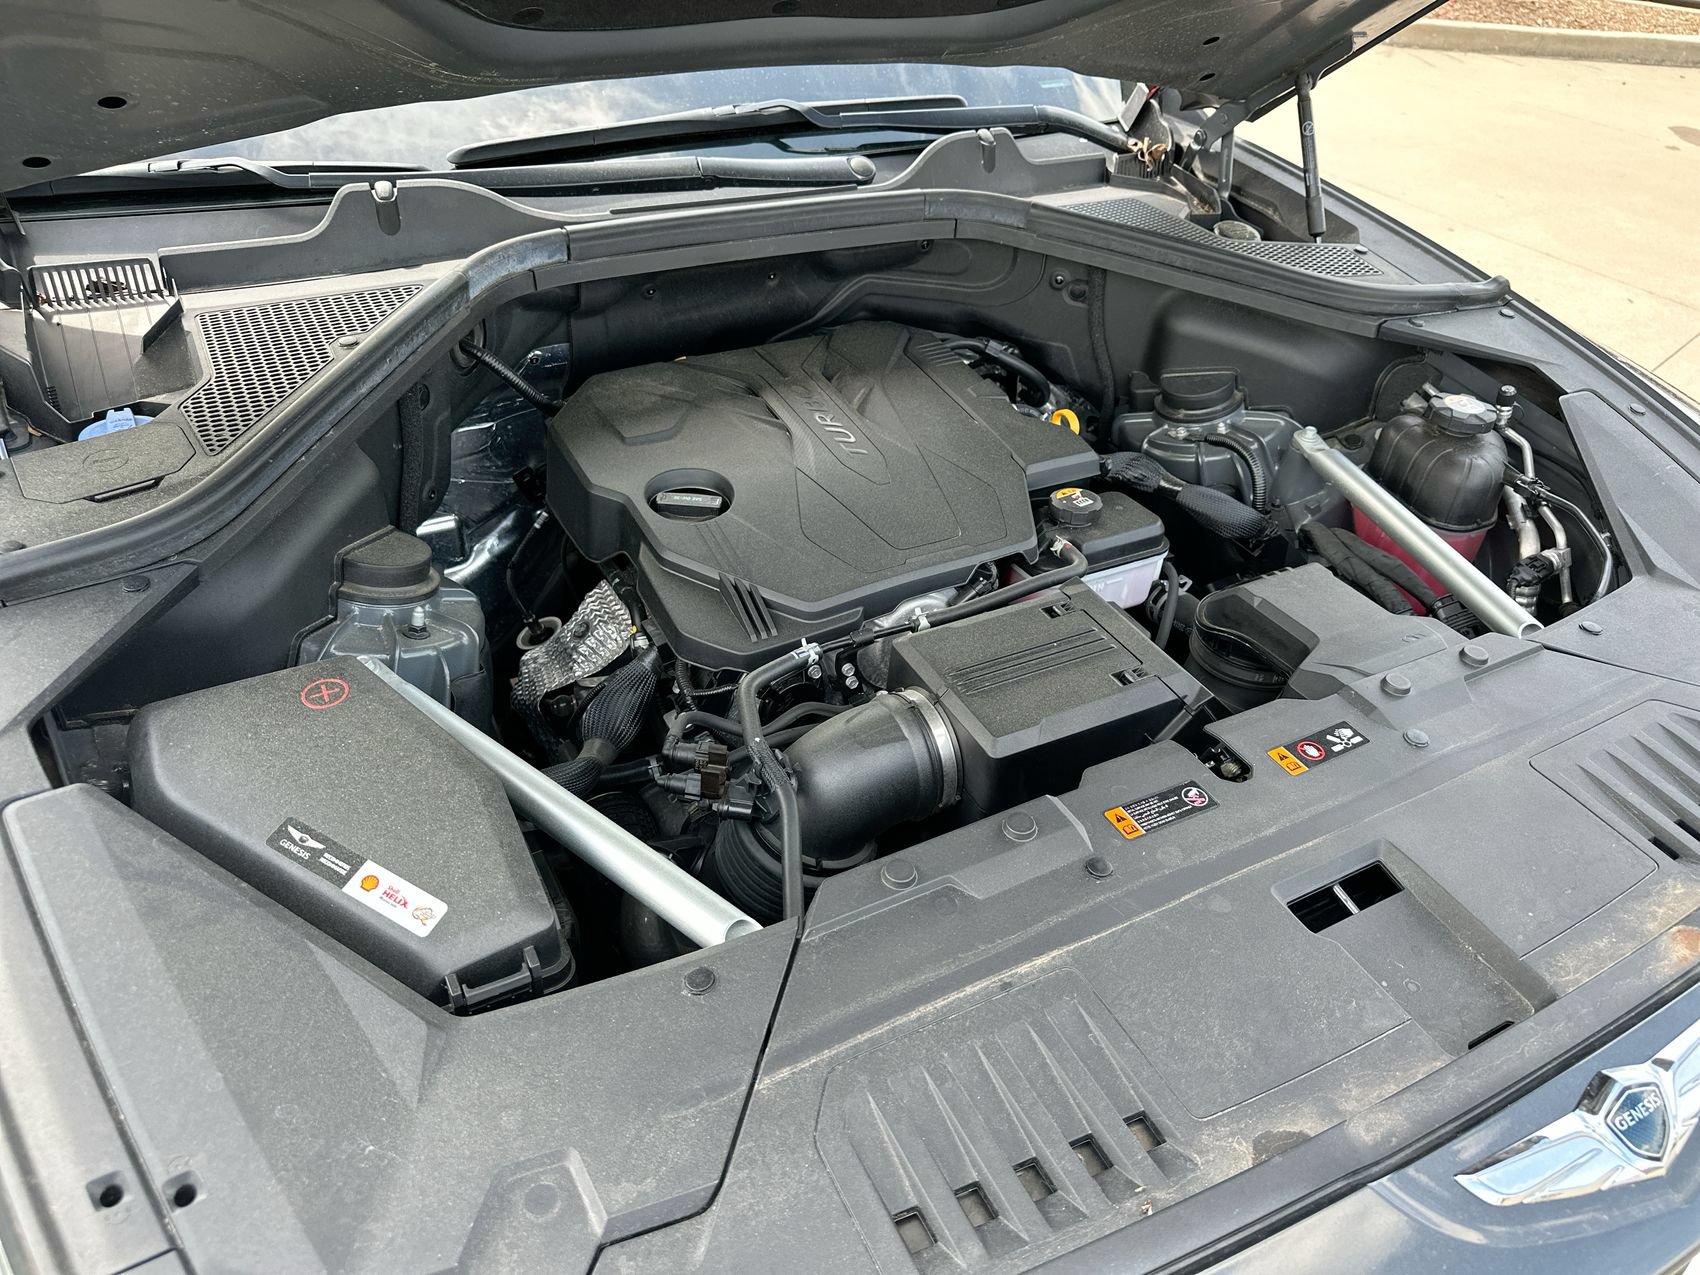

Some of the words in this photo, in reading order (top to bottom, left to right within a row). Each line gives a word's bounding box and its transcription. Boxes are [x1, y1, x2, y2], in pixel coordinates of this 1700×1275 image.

[280, 838, 311, 860] GENESIS
[382, 889, 409, 909] HELIX
[1614, 1092, 1661, 1131] GENESIS
